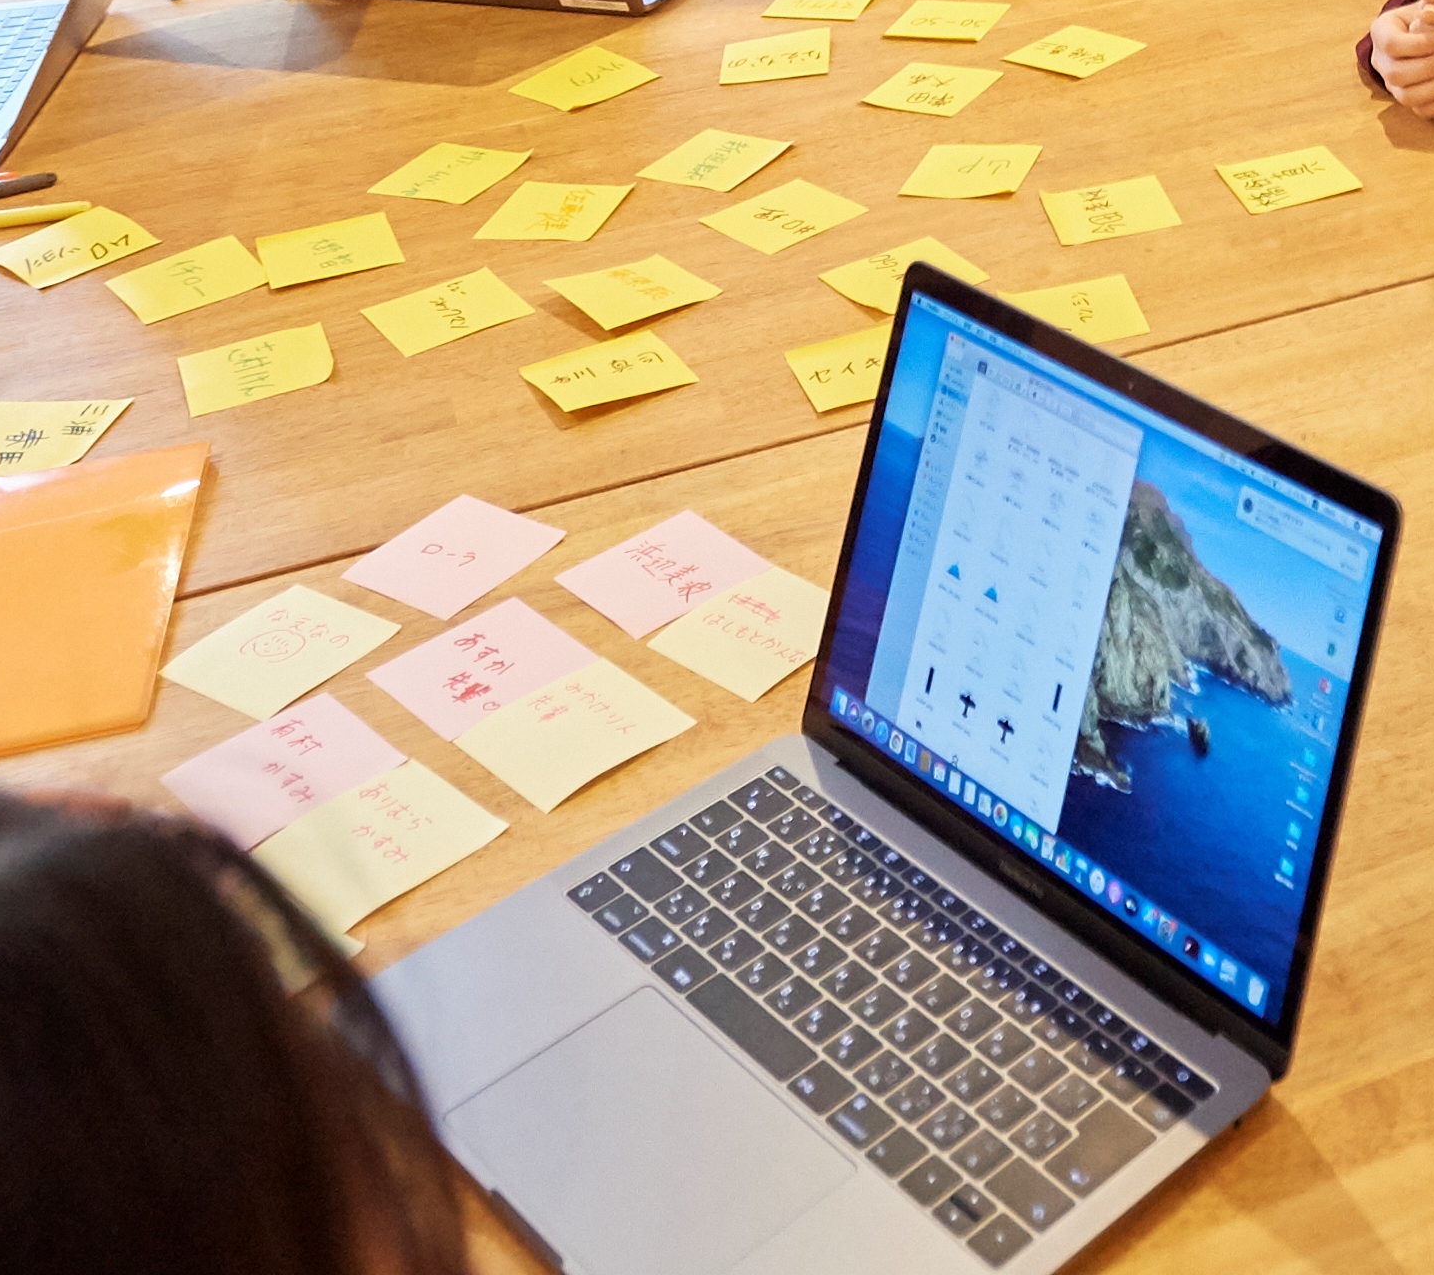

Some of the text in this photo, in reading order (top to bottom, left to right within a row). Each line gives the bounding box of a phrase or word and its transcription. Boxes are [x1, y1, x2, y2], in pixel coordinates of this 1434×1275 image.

[90, 233, 132, 261] ムロ
[168, 258, 206, 299] イチロー
[61, 402, 110, 438] 三浦
[419, 542, 478, 568] ローラ
[266, 606, 352, 649] なえなの
[452, 631, 516, 677] あすか
[442, 669, 493, 706] 先輩
[270, 716, 324, 757] 有村
[261, 759, 317, 806] かすみ
[357, 780, 434, 833] ありむら
[350, 821, 412, 865] かすみ
